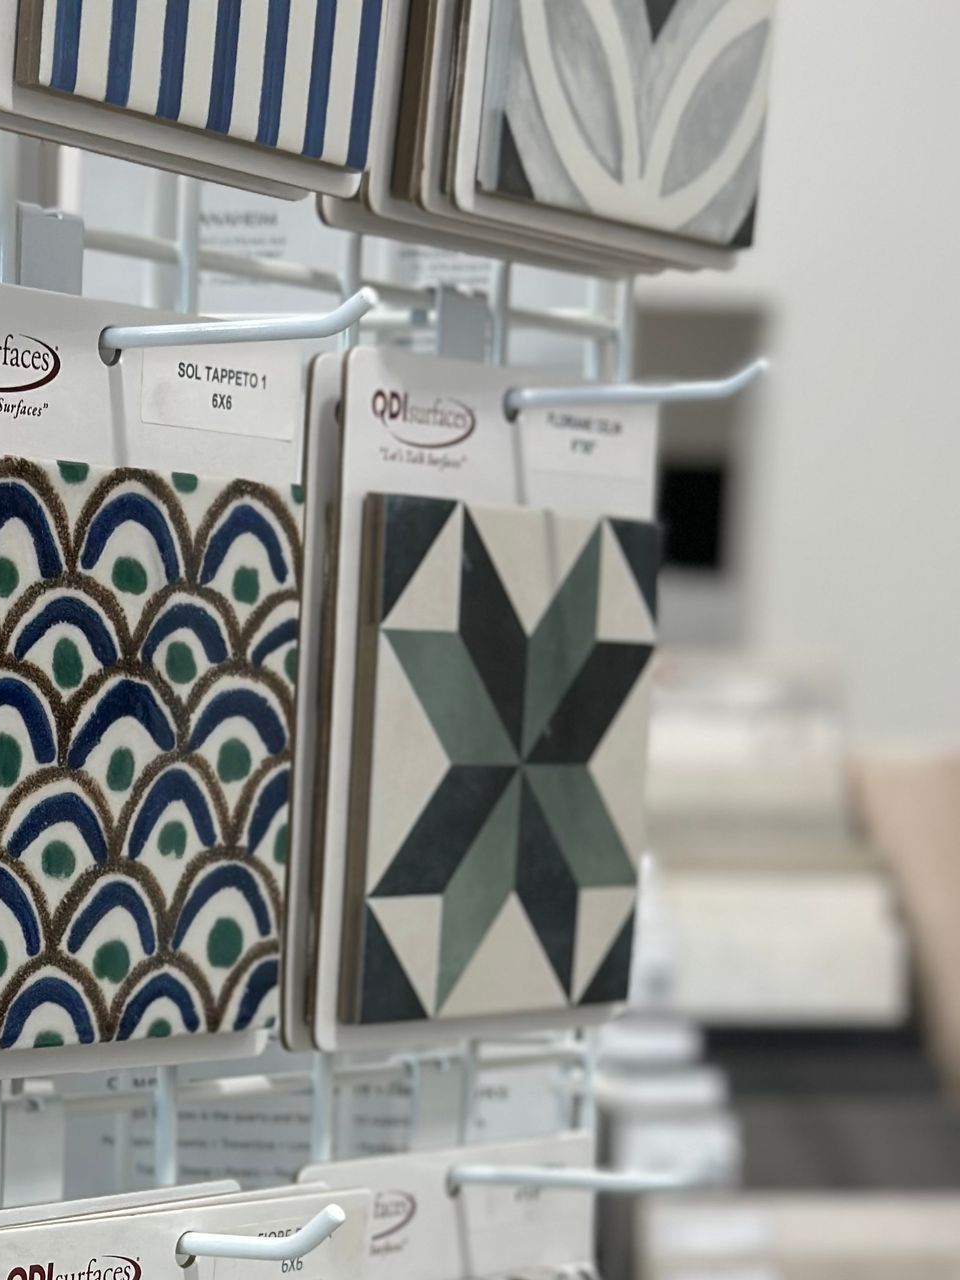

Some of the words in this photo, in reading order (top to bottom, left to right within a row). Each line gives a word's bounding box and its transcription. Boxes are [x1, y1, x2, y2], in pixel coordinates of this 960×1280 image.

[178, 362, 202, 381] SOL
[205, 366, 259, 389] TAPPETO
[261, 374, 267, 390] 1
[212, 393, 232, 410] 6X6
[281, 1258, 304, 1273] 6X6
